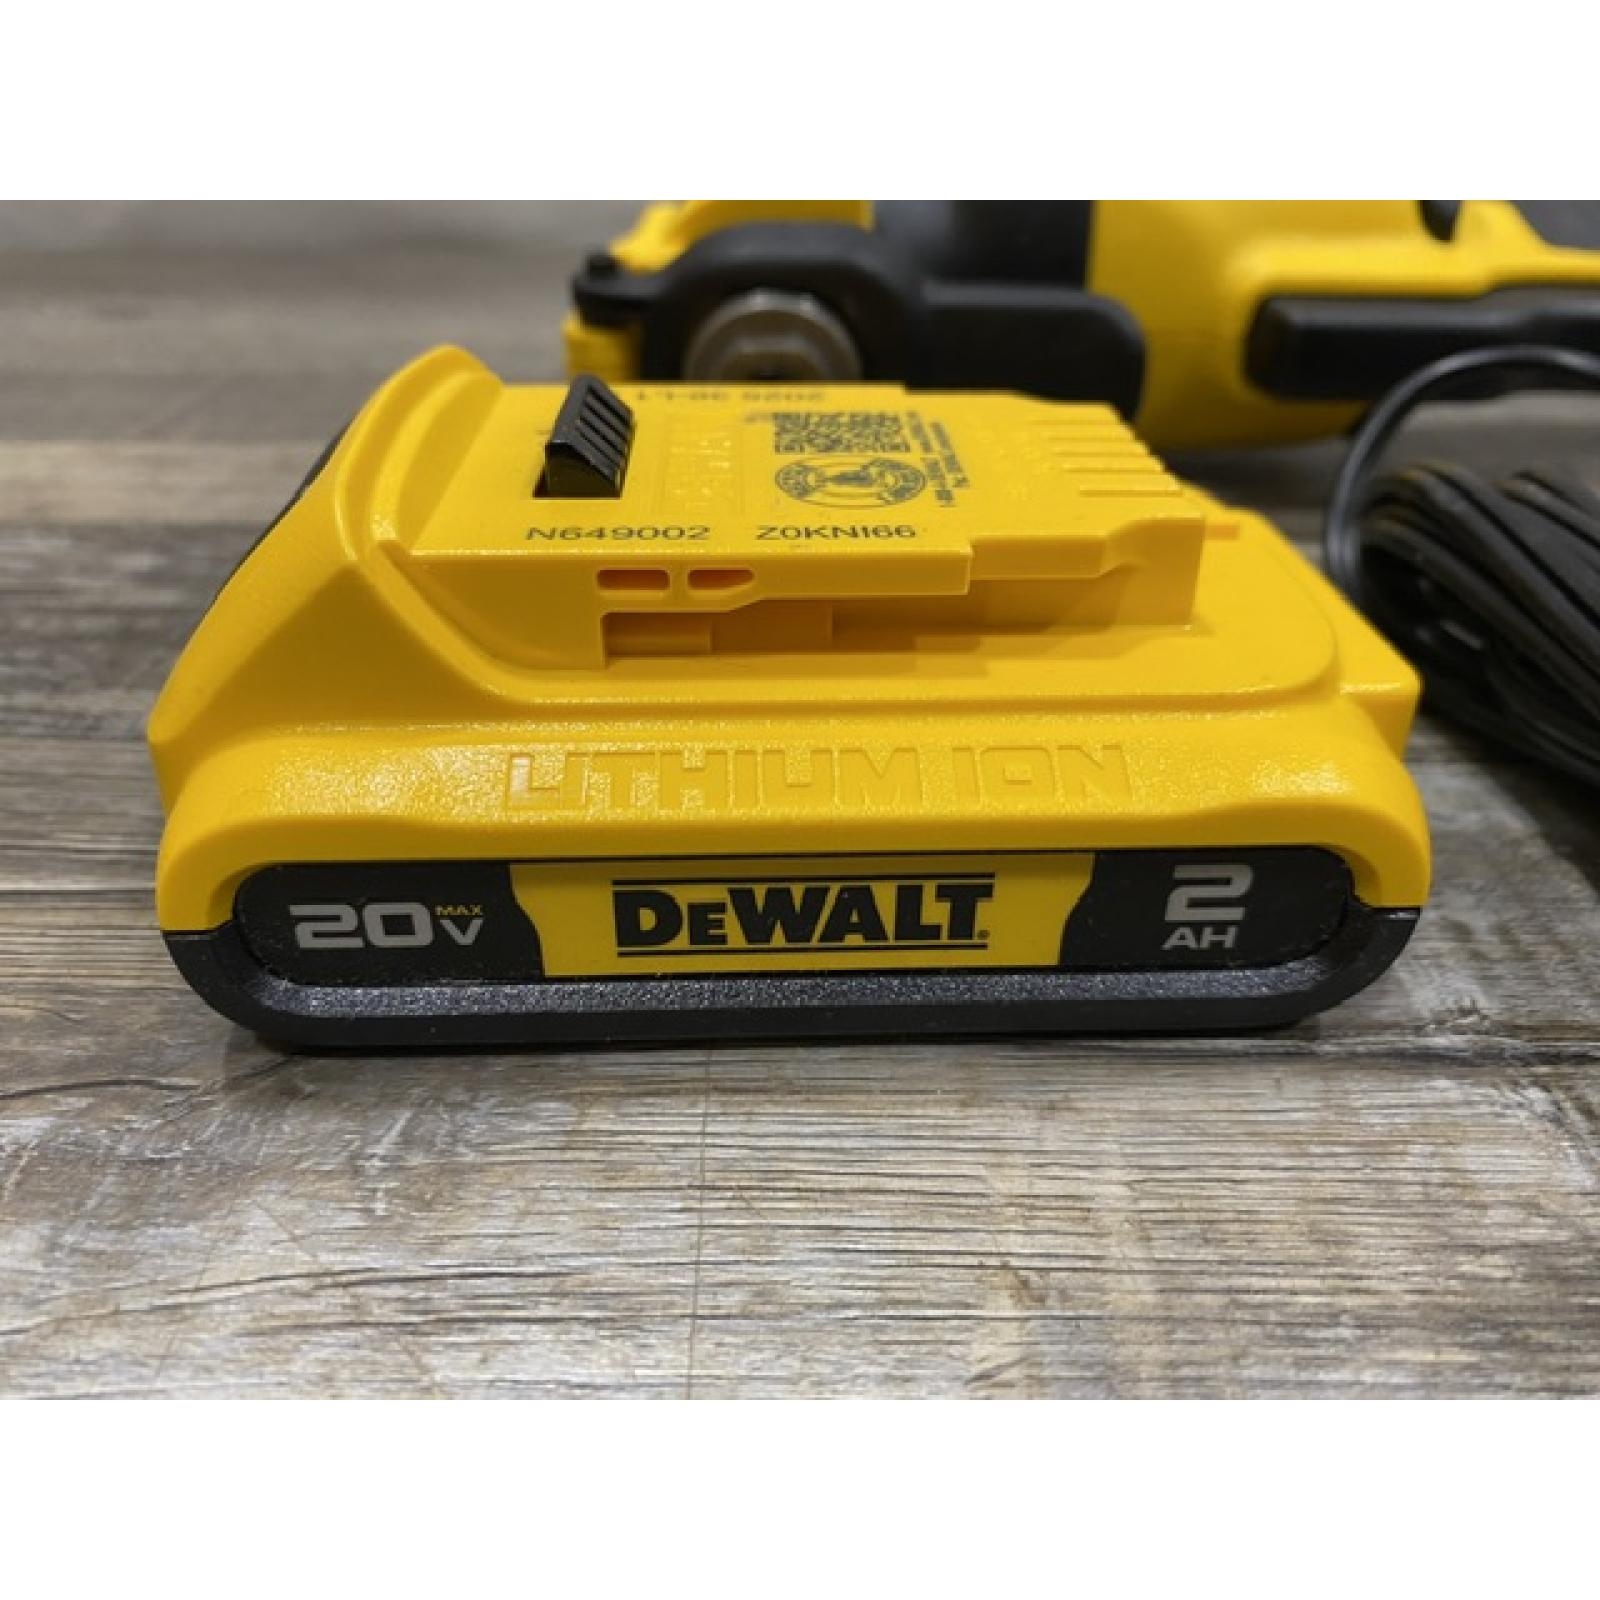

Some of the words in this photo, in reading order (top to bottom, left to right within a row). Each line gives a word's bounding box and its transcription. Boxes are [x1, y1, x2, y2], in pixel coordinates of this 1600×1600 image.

[525, 525, 711, 541] N649002
[507, 747, 923, 811] LITHIUM
[950, 744, 1134, 807] ION
[1164, 864, 1254, 921] 2
[434, 903, 482, 916] MAX
[1160, 926, 1239, 949] AH
